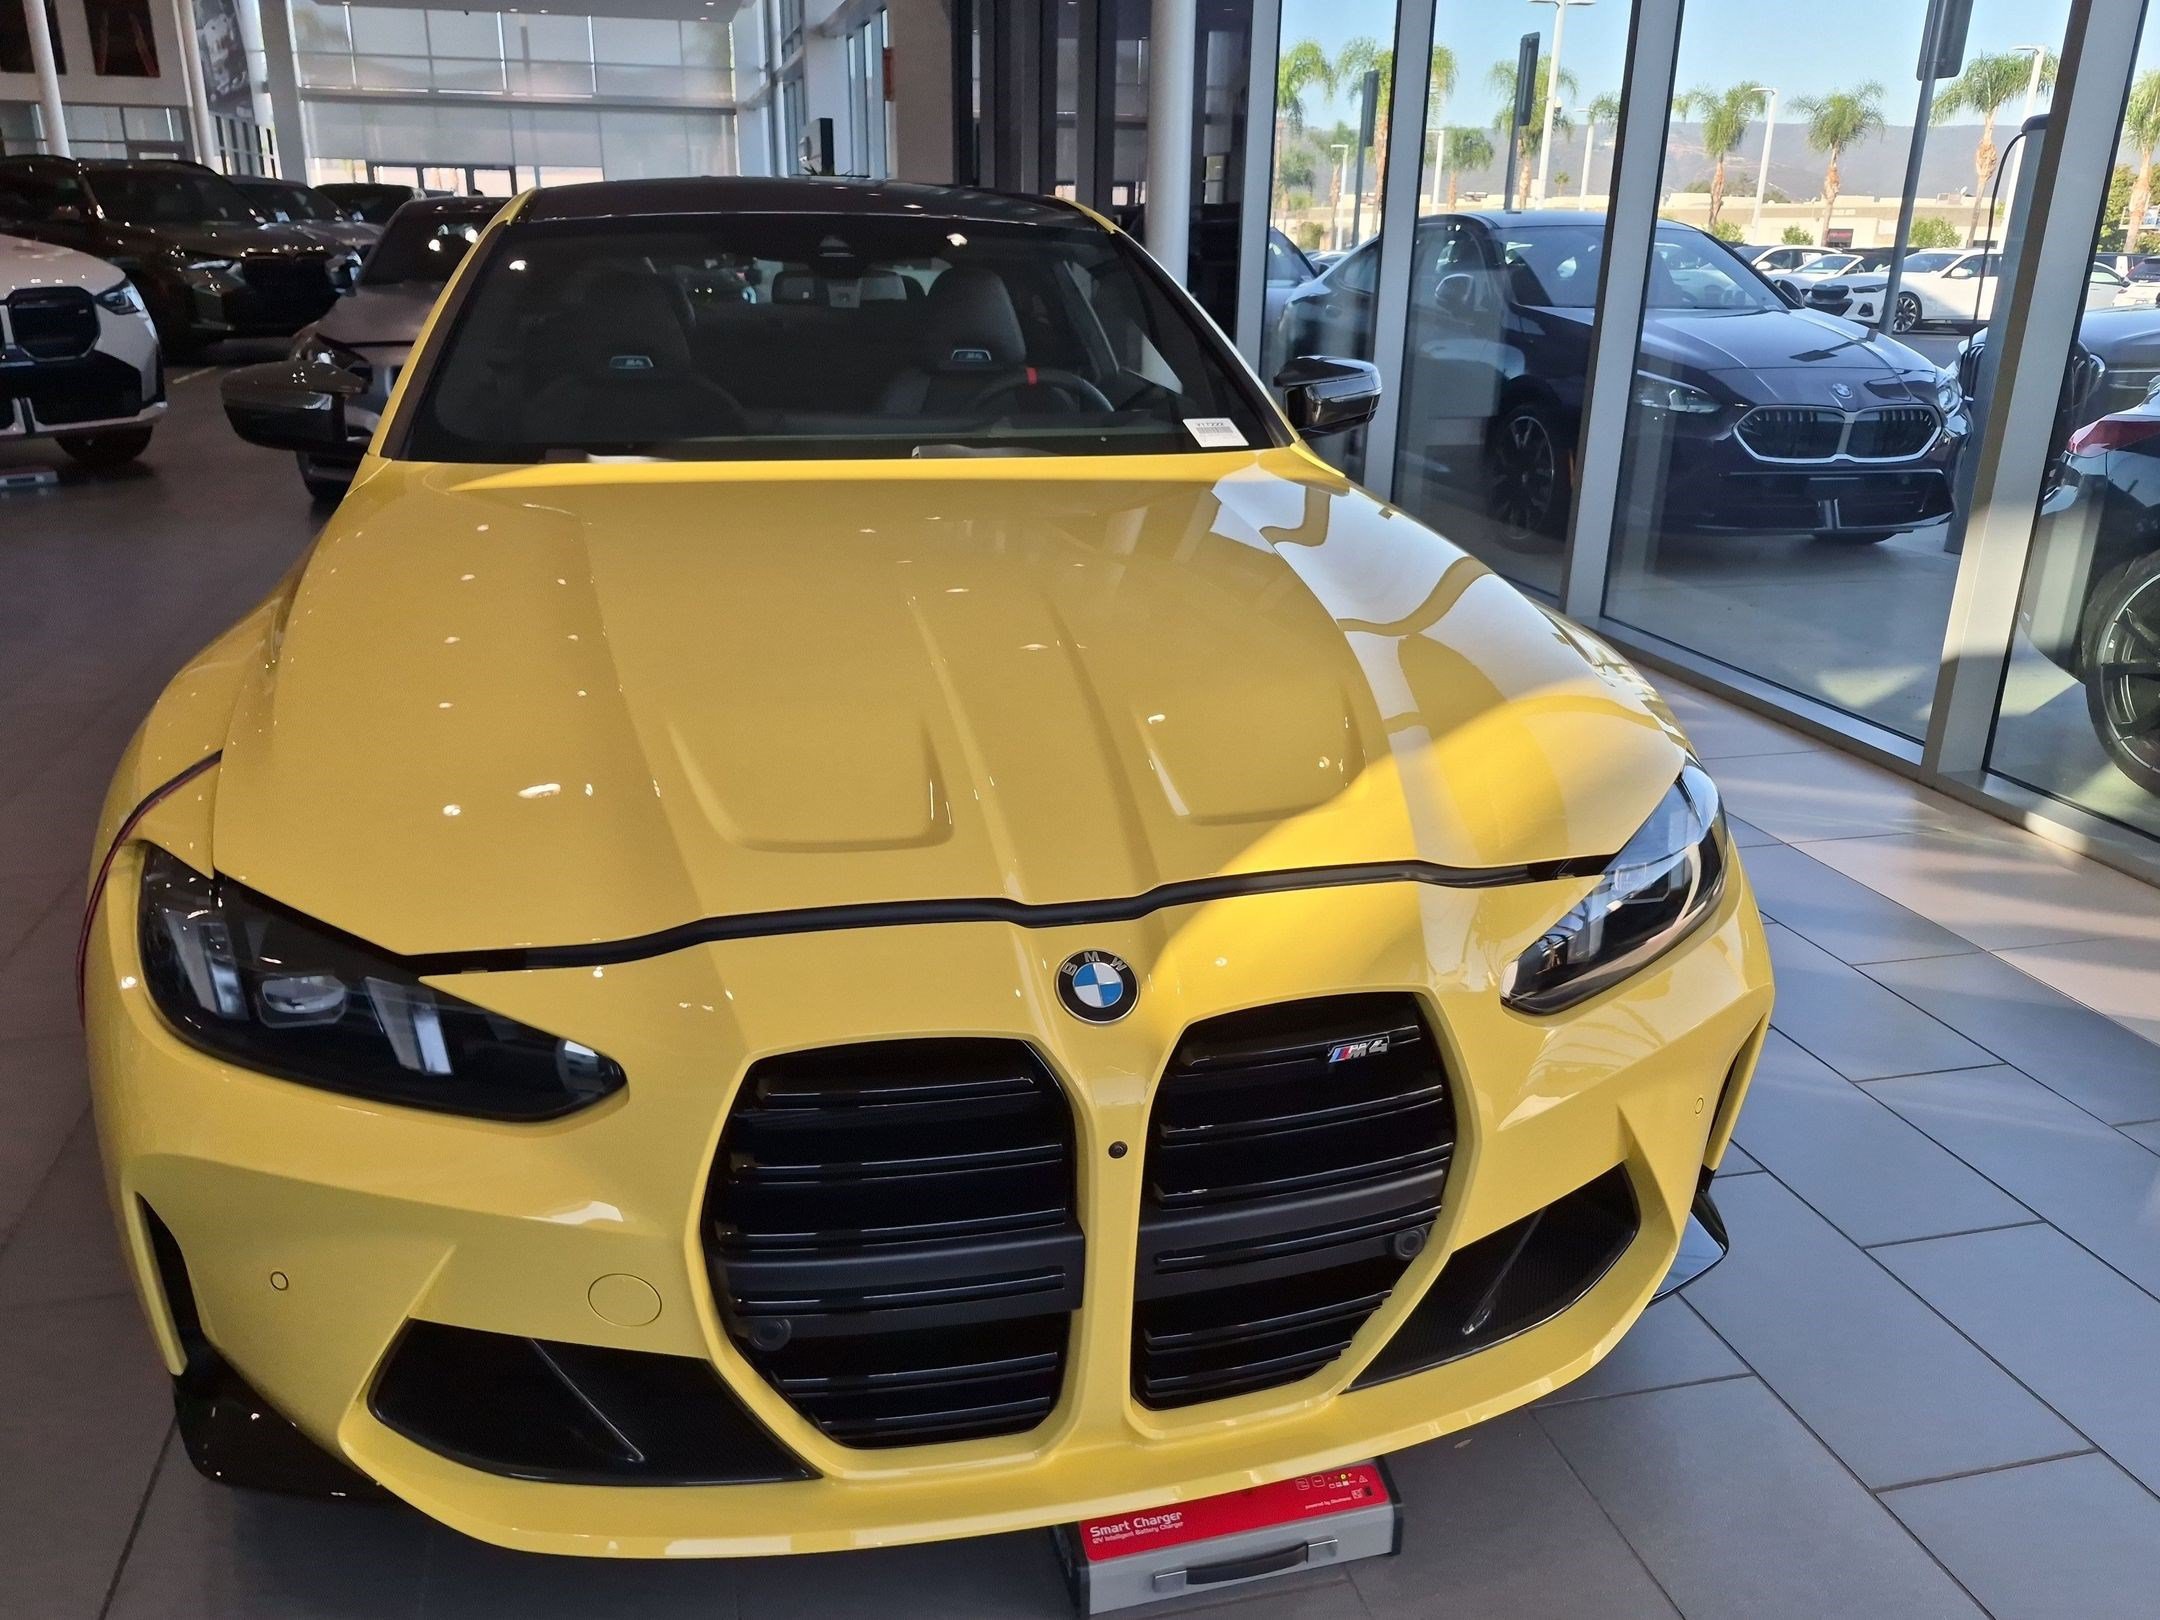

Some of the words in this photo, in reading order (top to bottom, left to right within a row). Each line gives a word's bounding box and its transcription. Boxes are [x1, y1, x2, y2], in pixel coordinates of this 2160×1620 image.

[1062, 951, 1127, 976] BMW
[1344, 1039, 1388, 1060] M4
[1090, 1520, 1131, 1538] Smart
[1133, 1511, 1183, 1528] Charger
[1135, 1526, 1160, 1536] Battery
[1160, 1521, 1184, 1529] Charger
